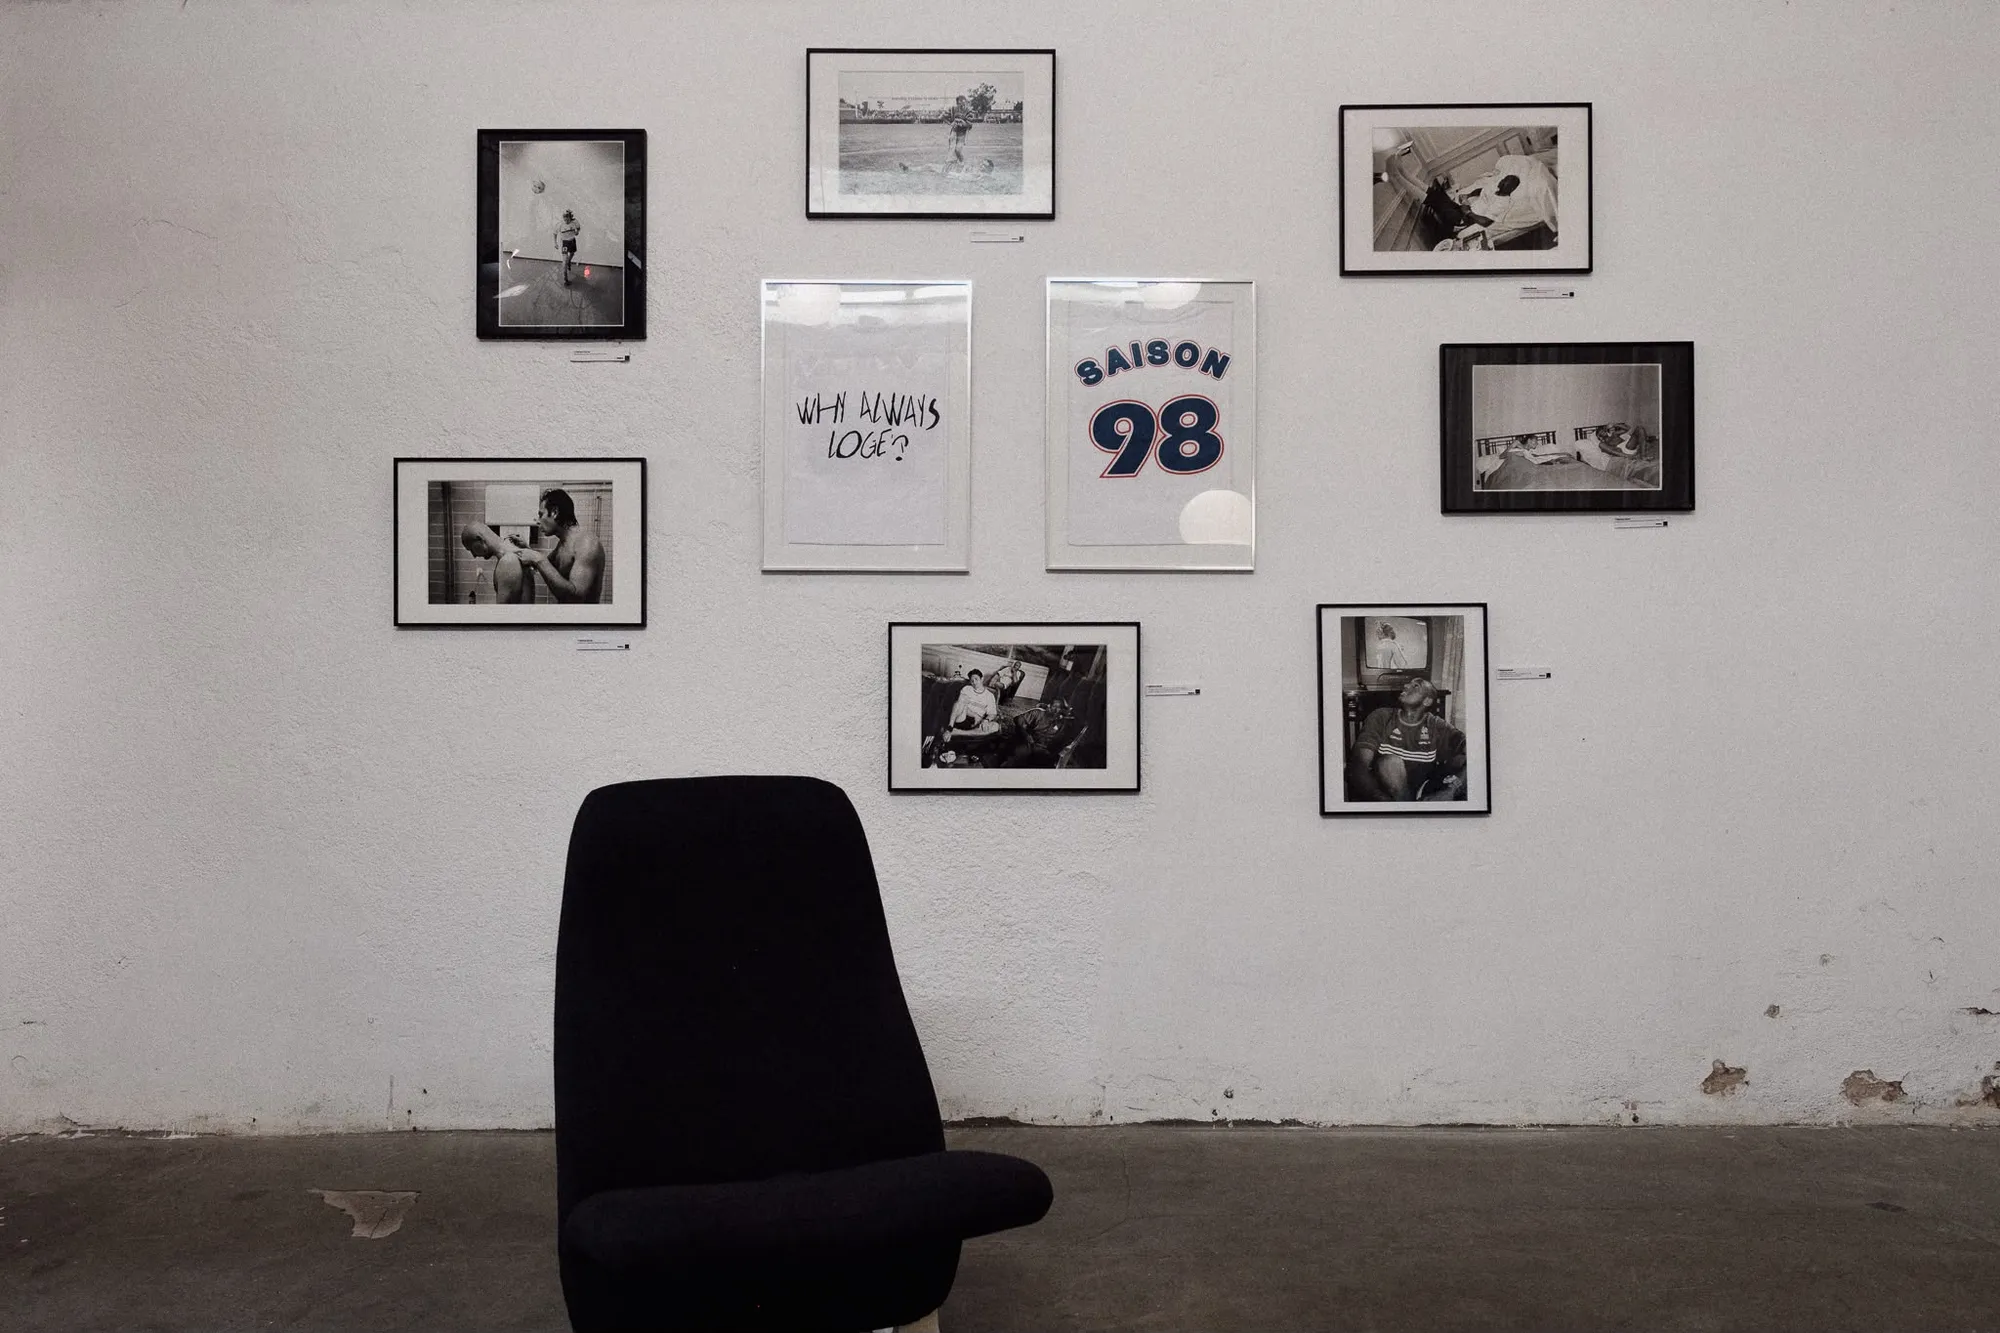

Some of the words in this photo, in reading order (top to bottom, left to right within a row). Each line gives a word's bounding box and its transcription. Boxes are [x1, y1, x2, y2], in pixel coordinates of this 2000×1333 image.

[1074, 338, 1232, 387] SAISON
[796, 391, 846, 425] WHY
[860, 390, 940, 430] ALWAYS
[828, 428, 909, 461] LOGE?
[1089, 394, 1225, 479] 98
